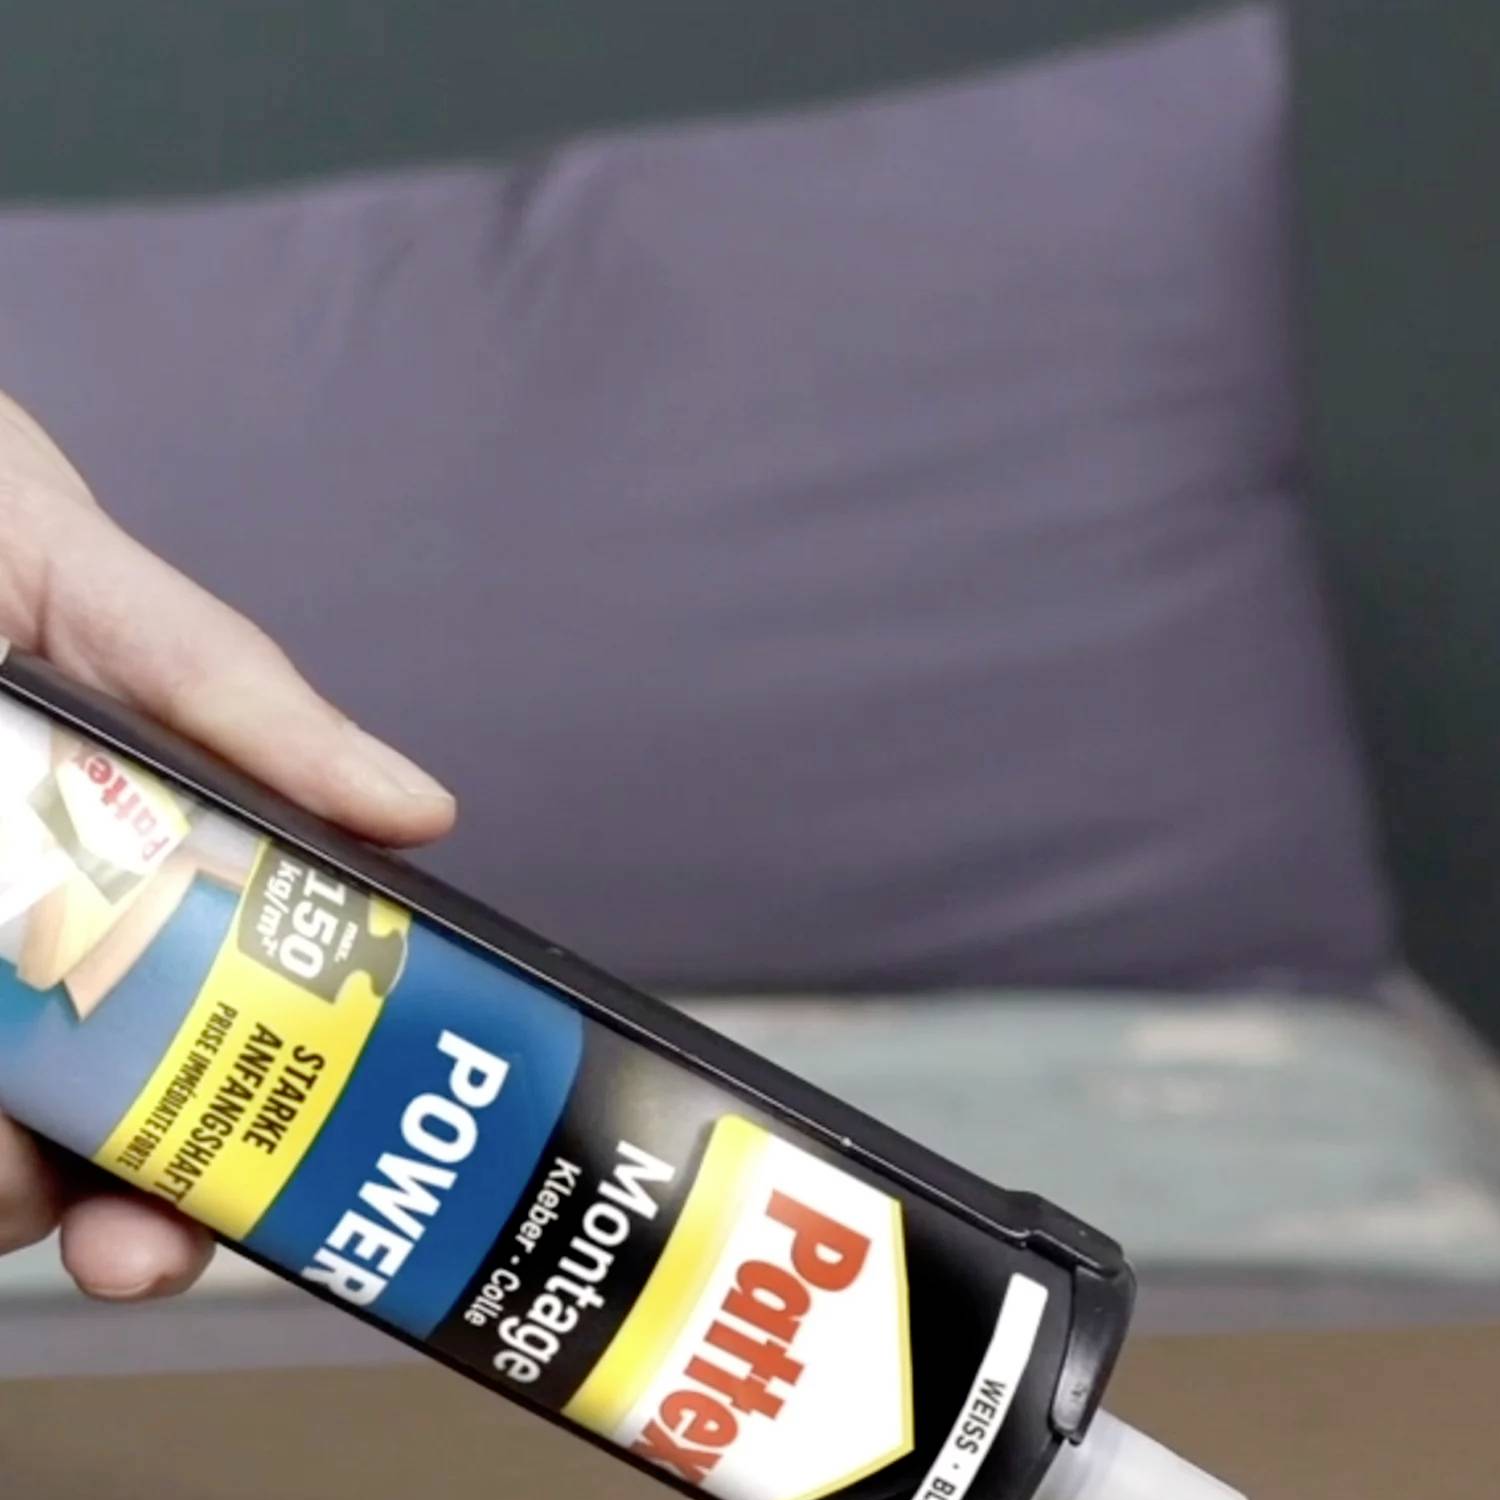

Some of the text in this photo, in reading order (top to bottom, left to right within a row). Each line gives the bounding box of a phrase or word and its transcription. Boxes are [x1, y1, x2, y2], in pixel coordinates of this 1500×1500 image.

[278, 868, 347, 980] 150
[115, 1001, 239, 1171] PRISE IMMÉDIATE FORTE
[153, 1021, 284, 1203] ANFANGSHAFT
[242, 1044, 325, 1155] STARKE
[300, 1028, 510, 1306] POWER
[463, 1156, 583, 1328] Kleber Colle
[492, 1139, 677, 1384] Montage
[631, 1188, 872, 1484] Pattex
[954, 1375, 1008, 1456] WEISS
